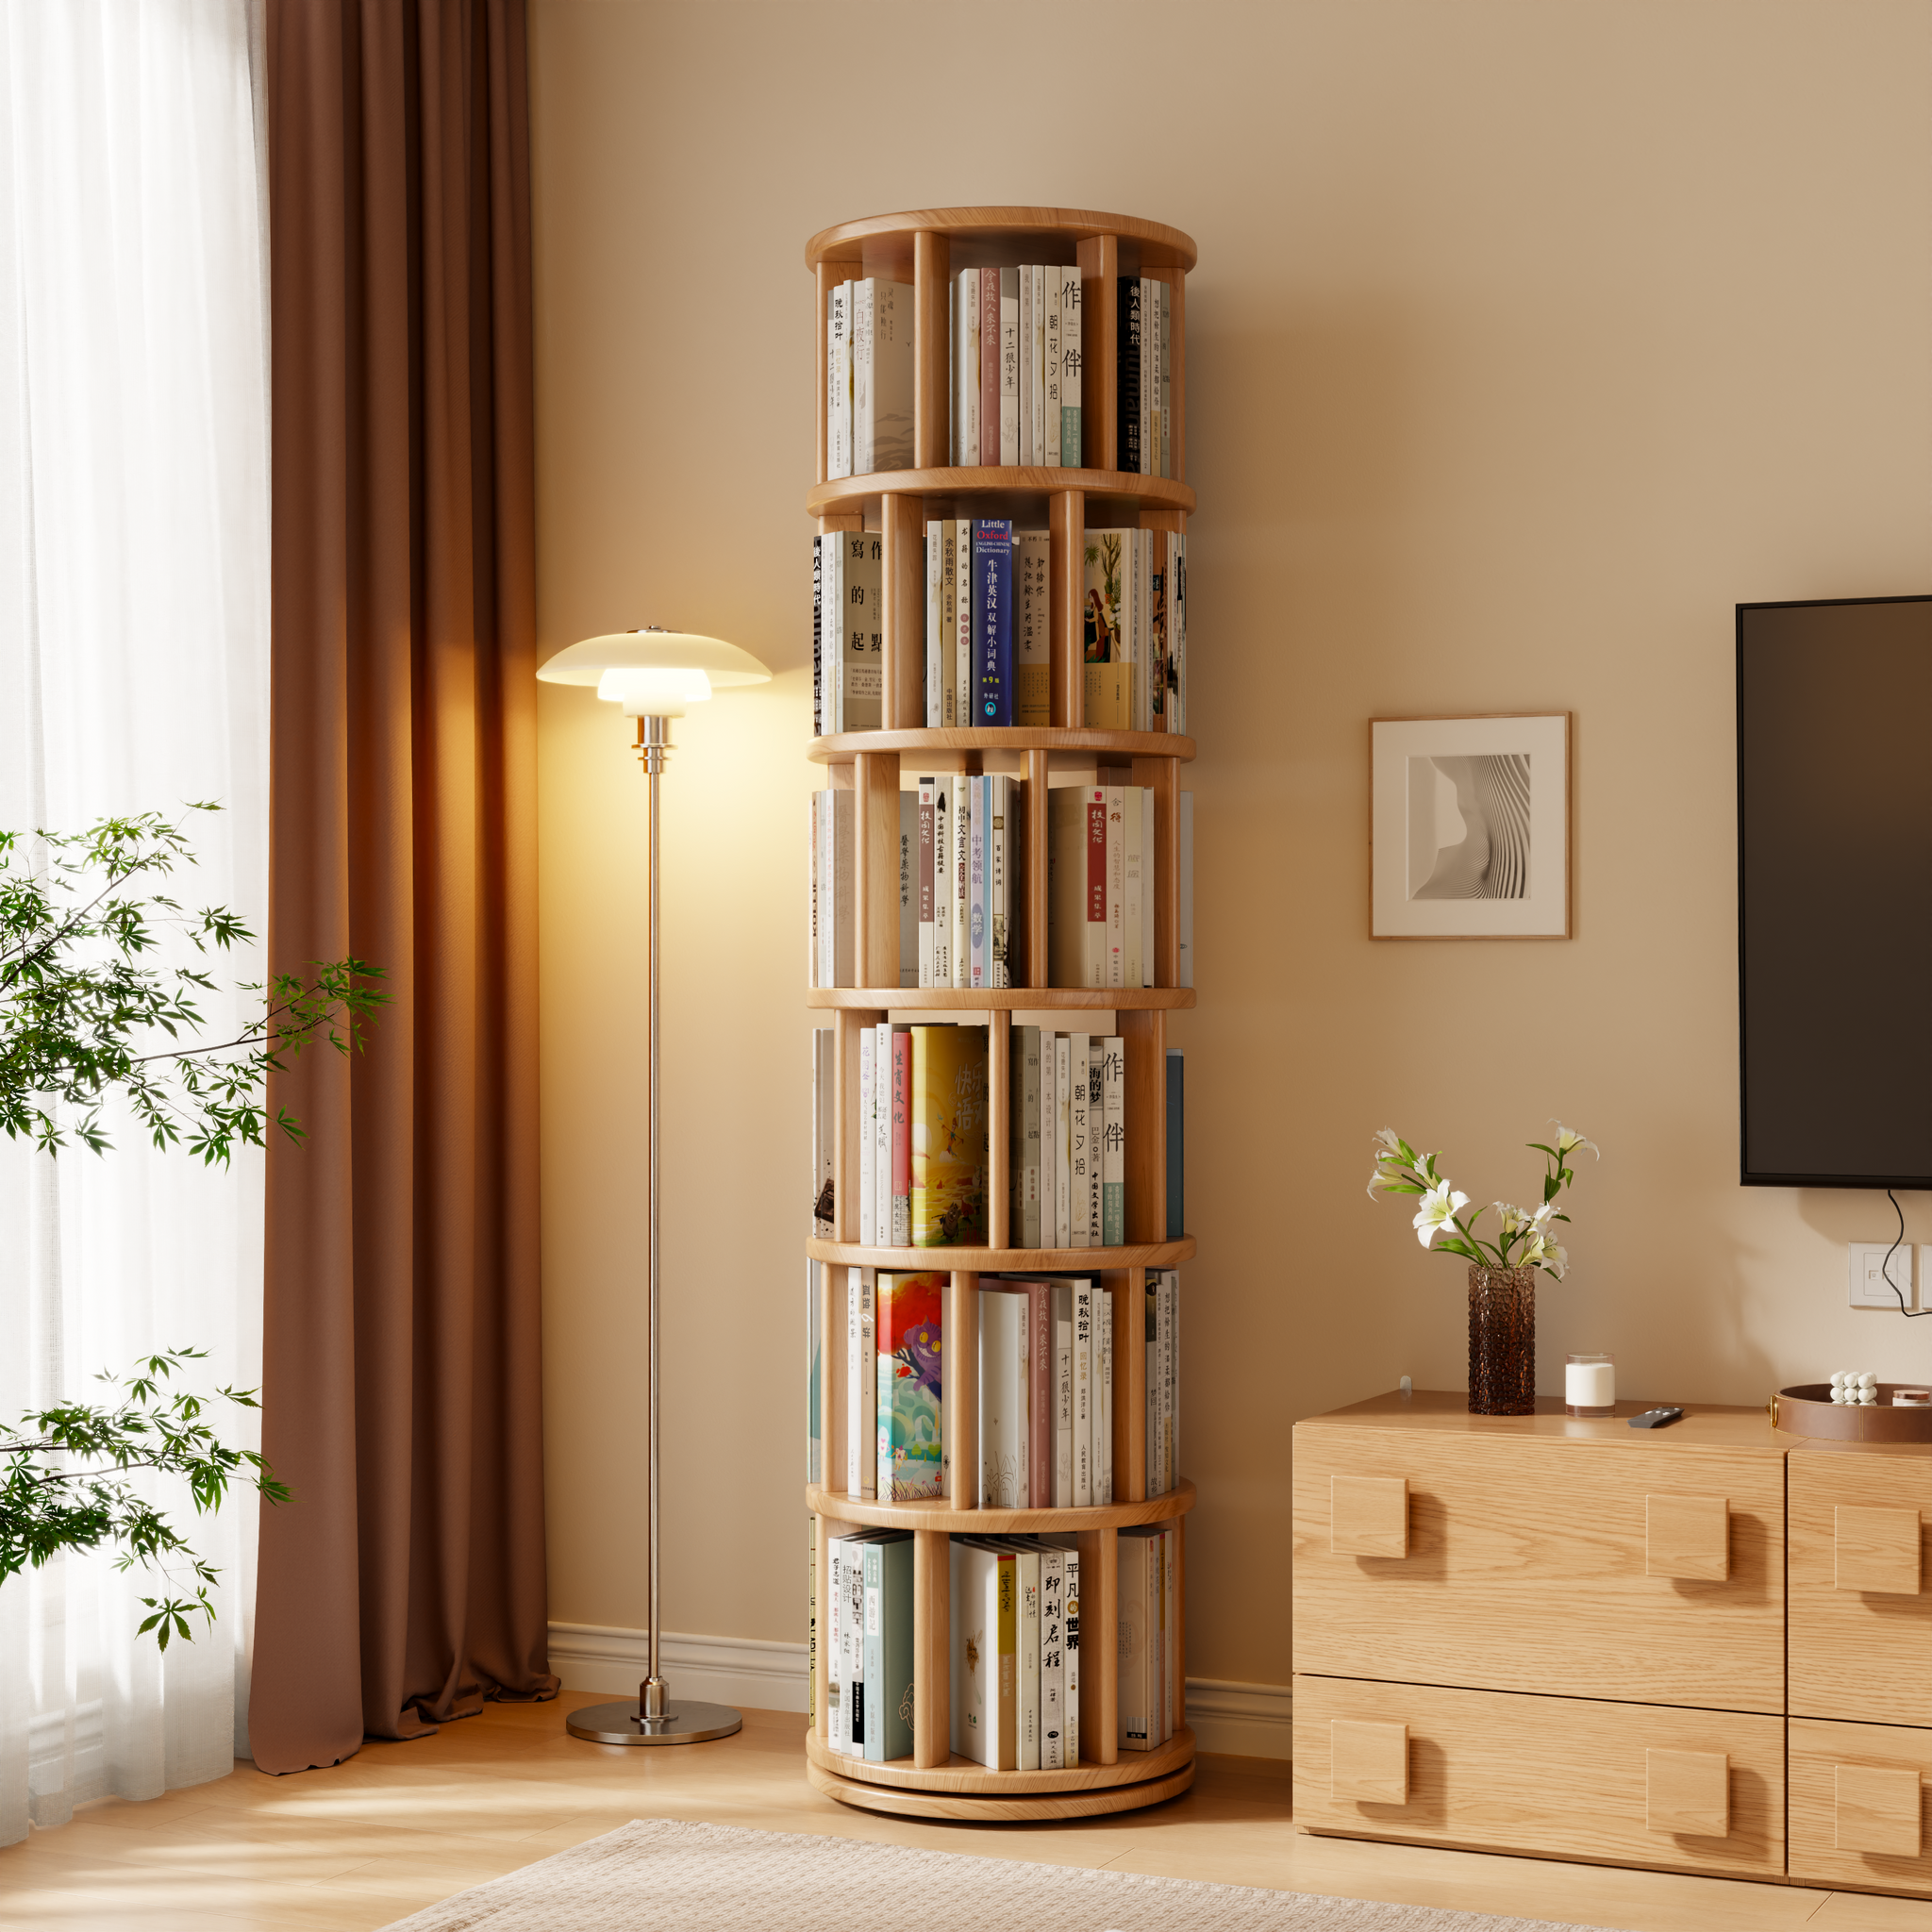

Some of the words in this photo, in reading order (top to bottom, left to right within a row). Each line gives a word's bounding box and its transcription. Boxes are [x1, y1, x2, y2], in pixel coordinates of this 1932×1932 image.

[834, 298, 843, 341] 晚秋拾叶
[856, 308, 865, 360] 白夜行
[1130, 286, 1141, 345] 後人類時代
[1005, 327, 1016, 390] 十二狼少年
[1049, 314, 1058, 400] 朝花夕拾
[976, 530, 1008, 541] Oxford
[981, 519, 1006, 529] Little
[945, 538, 954, 587] 余秋雨散文
[960, 527, 969, 605] 书籍的名称
[975, 546, 1010, 556] Dictionary
[851, 585, 864, 607] 的
[987, 558, 998, 672] 牛津英汉双解小词典
[982, 675, 1000, 684] 第9版
[958, 805, 966, 861] 初中文言文
[1109, 797, 1122, 824] 舍得
[972, 834, 983, 885] 中考领航
[1112, 840, 1121, 891] 人生的智慧和态度
[972, 912, 983, 935] 数学
[893, 1049, 906, 1124] 生肖文化
[1089, 1067, 1101, 1104] 海的梦
[1074, 1084, 1086, 1175] 朝花夕拾
[1091, 1172, 1100, 1238] 中国文学出版社
[1078, 1293, 1090, 1343] 晚秋拾叶
[1061, 1354, 1071, 1423] 十二狼少年
[1079, 1351, 1088, 1381] 回忆录
[842, 1564, 852, 1604] 招贴设计
[1066, 1563, 1079, 1651] 平凡的世界
[1042, 1575, 1061, 1669] 即刻启程
